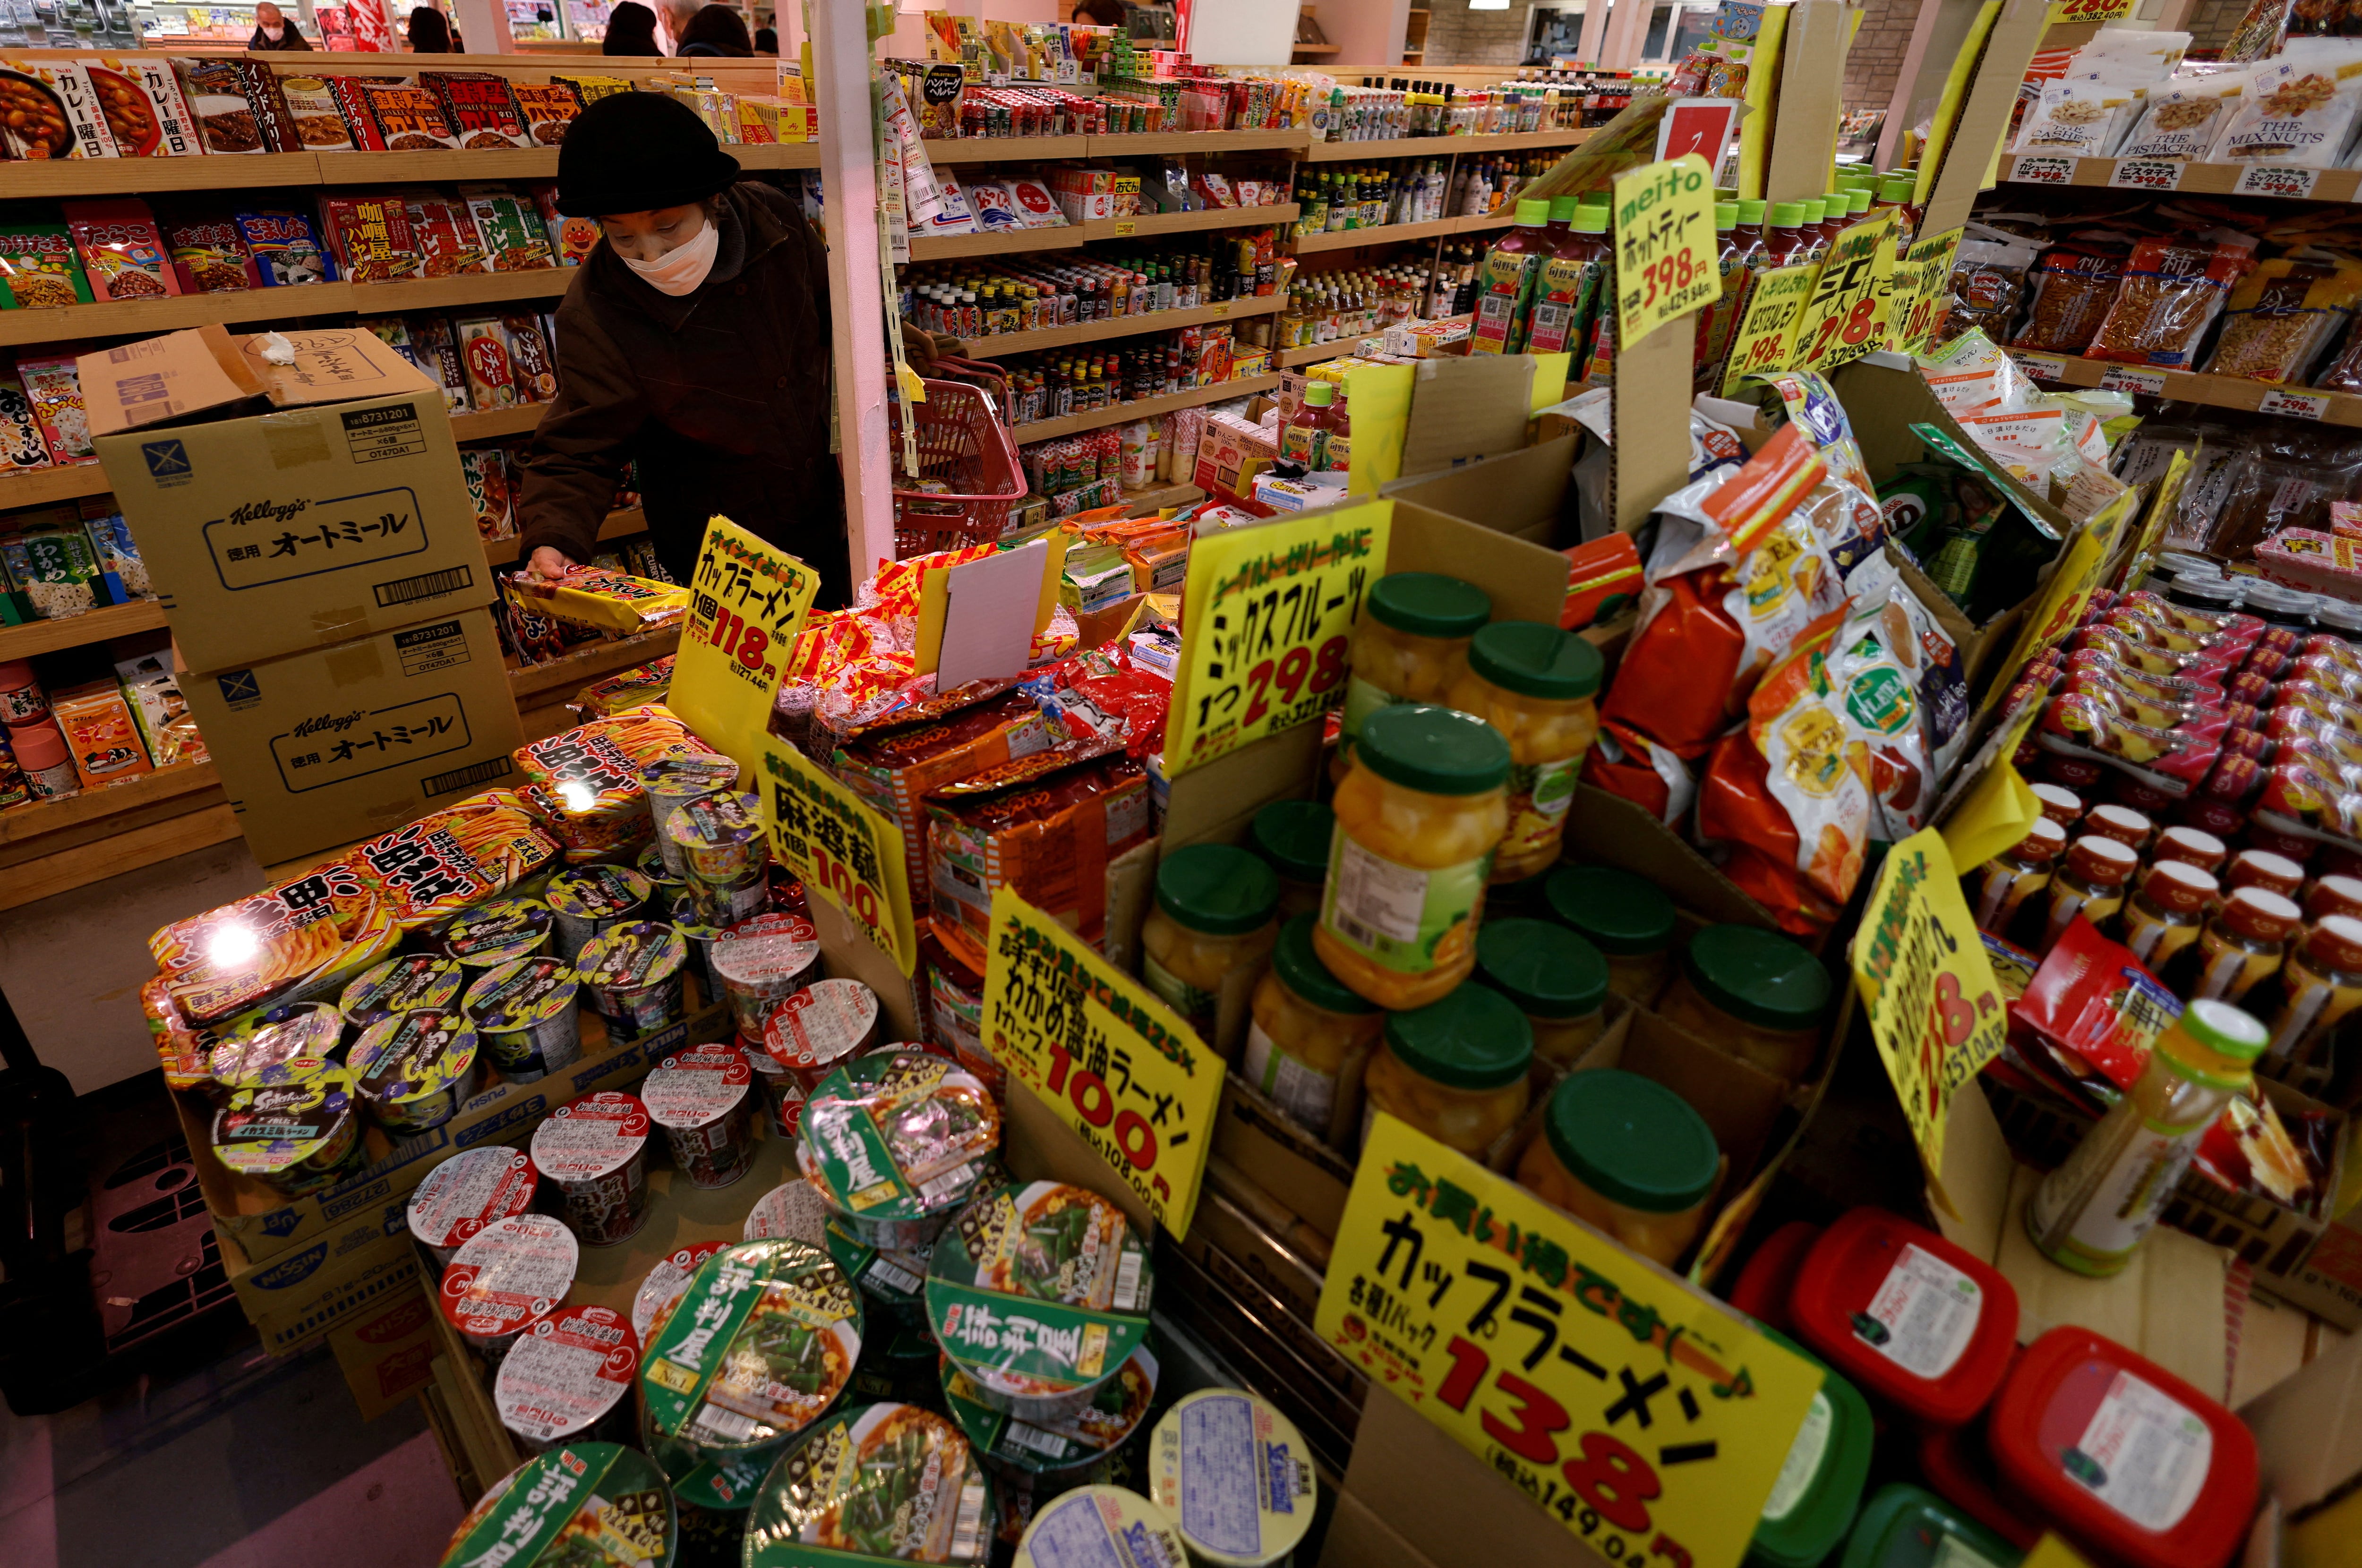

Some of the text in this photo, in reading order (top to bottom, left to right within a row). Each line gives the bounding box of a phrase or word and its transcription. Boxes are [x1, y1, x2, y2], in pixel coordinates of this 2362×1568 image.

[925, 77, 961, 87] ハンバーグ
[929, 88, 956, 96] ヘルパー
[58, 75, 102, 158] カレー曜日
[145, 72, 188, 153] カレー曜日
[248, 64, 282, 152] インドカリー
[339, 80, 370, 151] インドカリー
[2053, 124, 2085, 134] THE
[2155, 134, 2189, 143] THE
[2226, 133, 2324, 145] MIX NUTS
[2260, 122, 2302, 132] THE
[2020, 162, 2071, 173] カシューナッツ
[2121, 167, 2176, 177] ピスタチオ
[2248, 173, 2311, 183] ミックスナッツ
[1116, 181, 1140, 193] おでん
[1620, 169, 1702, 229] meito
[0, 234, 71, 255] のりたま
[83, 224, 152, 249] たらこ
[173, 223, 237, 247] 味道楽
[244, 217, 308, 242] ごましお
[417, 225, 438, 266] カレー
[488, 219, 507, 263] カレー
[1624, 209, 1700, 273] ホットティー
[348, 227, 371, 280] ハヤシ
[1492, 258, 1518, 273] 旬野菜
[2160, 253, 2214, 285] 柿ピー
[1549, 266, 1577, 280] 旬野菜
[480, 341, 497, 384] シチュー
[518, 331, 537, 374] シチュー
[1217, 343, 1227, 374] ほんだし
[1743, 333, 1785, 371] 198円
[2280, 399, 2314, 412] 298円
[0, 389, 49, 465] おむすび山
[1217, 431, 1232, 441] りんご
[1240, 436, 1254, 446] 200ml
[1288, 432, 1309, 443] 旬野菜
[368, 445, 411, 459] OT47DA1
[1262, 447, 1276, 456] 62368
[1330, 442, 1350, 452] 旬野菜
[230, 499, 308, 526] Kellogg's
[227, 513, 409, 562] 徳用 オートミール
[34, 543, 67, 582] わかめ
[67, 541, 89, 574] 混ぜ込み
[699, 549, 795, 630] カップラーメン
[692, 588, 776, 681] 1個 118円
[1210, 567, 1365, 678] ミックスフルーツ
[419, 657, 456, 671] OT47DA1
[729, 660, 769, 693] (税込127.44円)
[1198, 685, 1240, 727] 1つ
[293, 710, 363, 738] Kellogg's
[291, 716, 454, 769] 徳用 オートミール
[362, 824, 476, 903] 油そば
[1004, 966, 1189, 1148] わかめ醤油ラーメン
[253, 1089, 311, 1113] Splatoon
[468, 1086, 506, 1110] PUSH
[995, 1002, 1170, 1202] 1カップ 100円
[1075, 1118, 1168, 1224] (税込108.00円)
[327, 1182, 387, 1217] 27286
[268, 1210, 293, 1230] UP
[261, 1249, 322, 1286] NISSIN
[667, 1260, 755, 1371] 評判屋
[1347, 1275, 1437, 1352] 各種1パック
[956, 1303, 1081, 1368] 評判屋
[1376, 1211, 1717, 1466] カップラーメン
[660, 1371, 685, 1388] No.1
